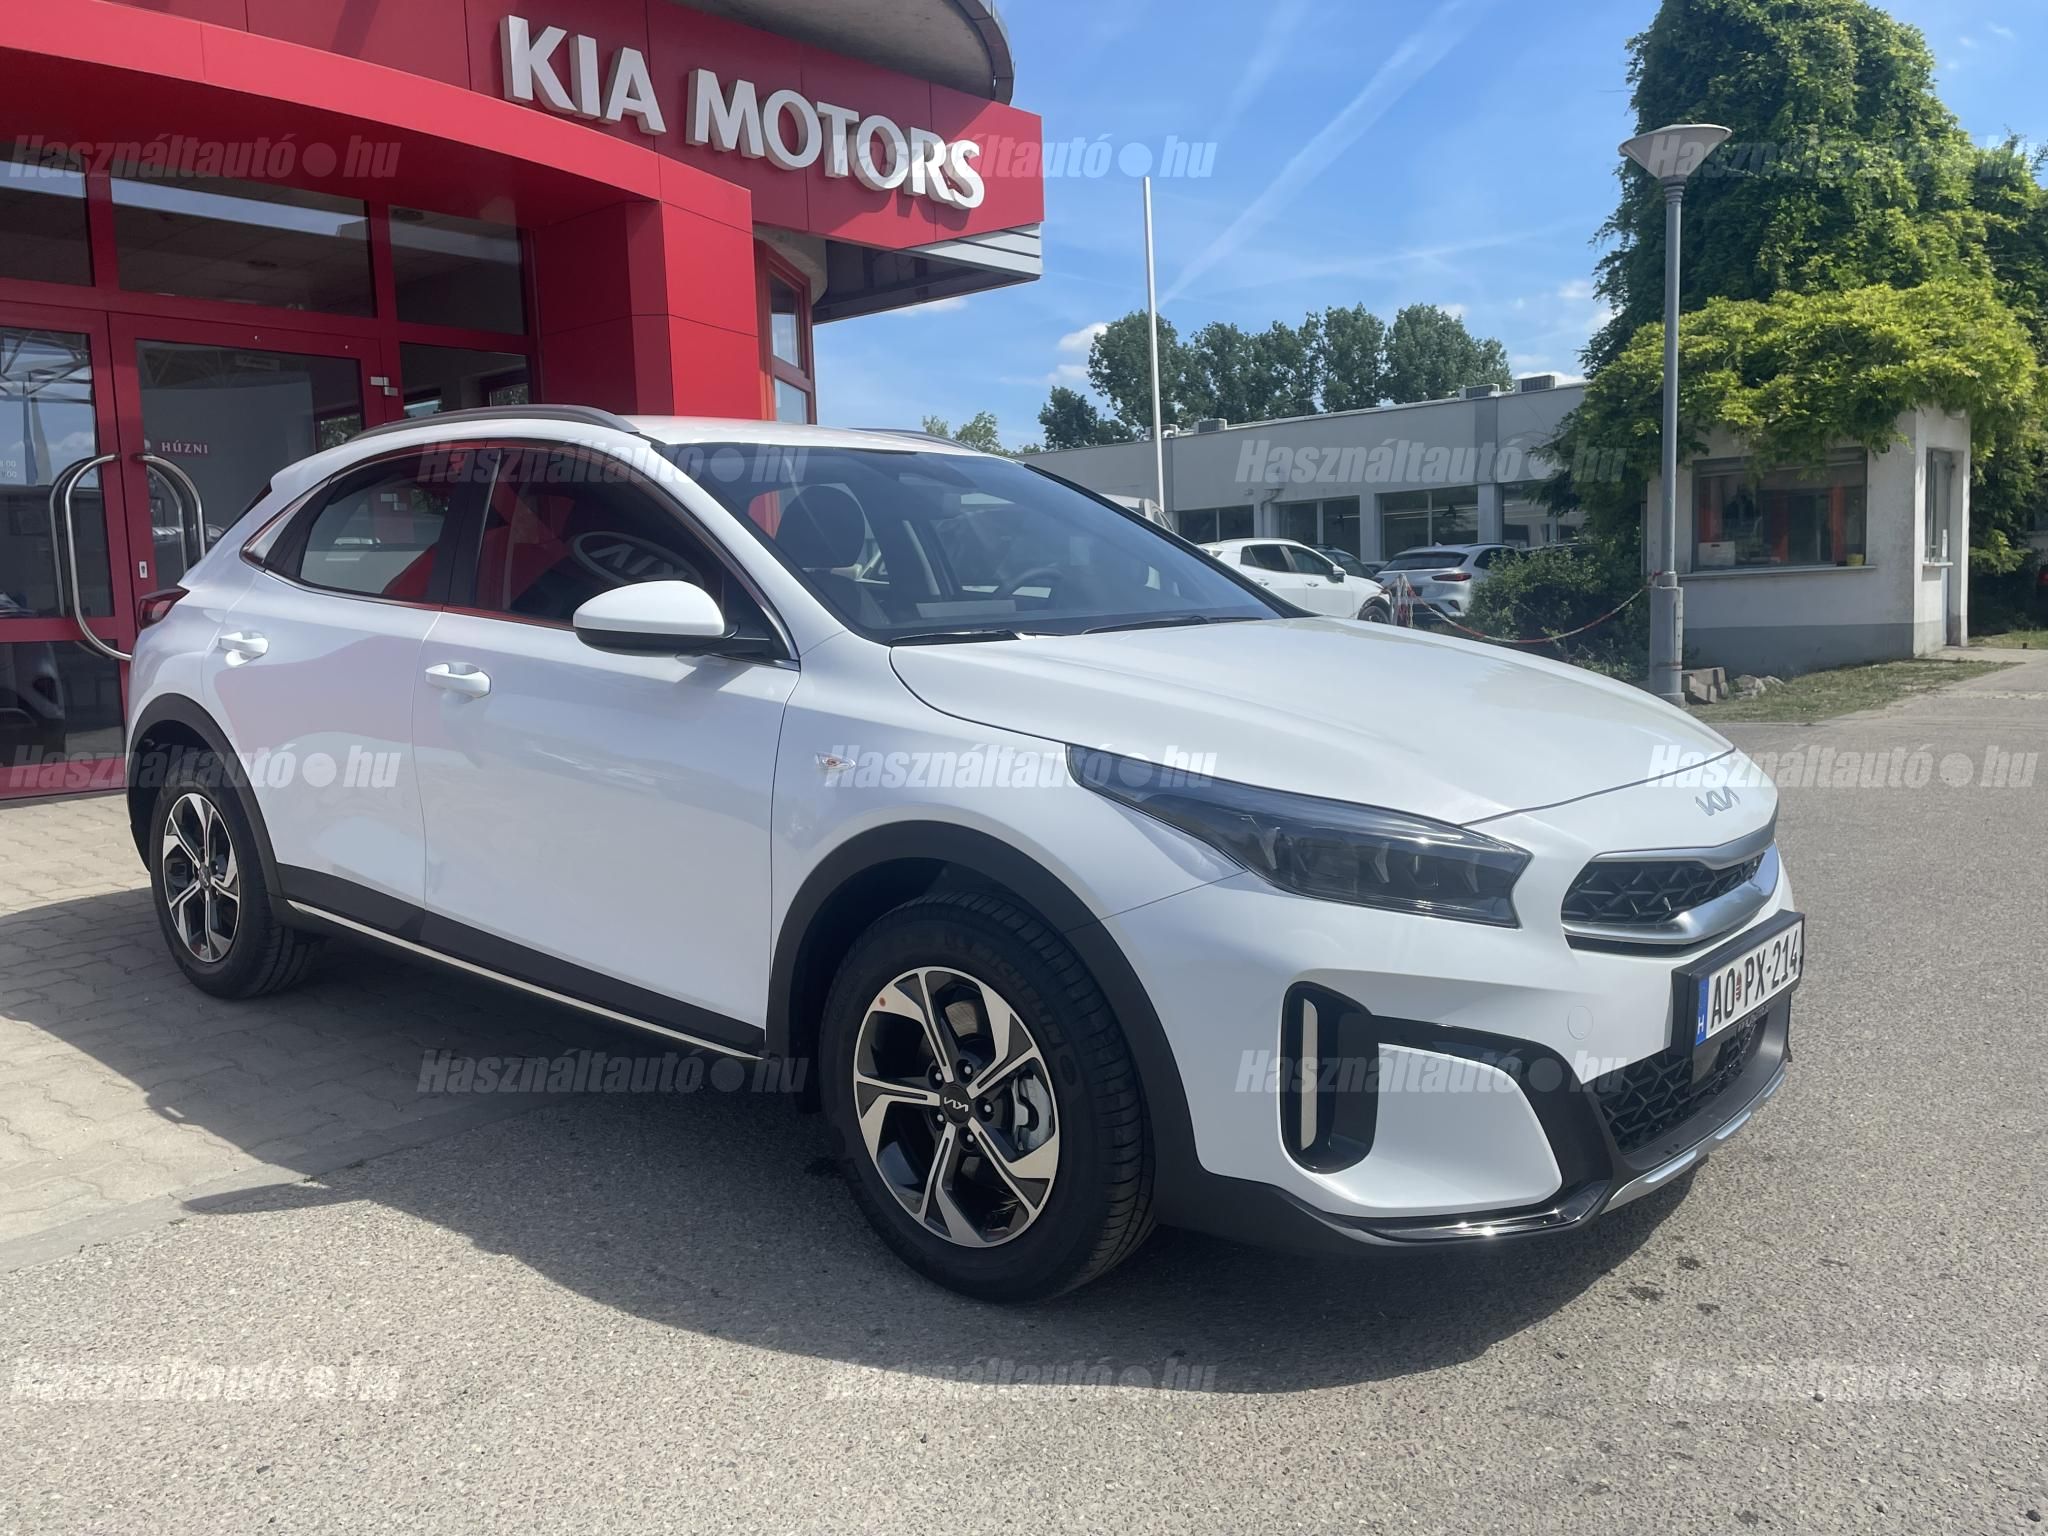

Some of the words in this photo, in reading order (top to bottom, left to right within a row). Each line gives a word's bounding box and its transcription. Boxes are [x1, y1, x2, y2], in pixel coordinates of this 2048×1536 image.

[501, 15, 666, 135] KIA
[686, 68, 985, 209] MOTORS
[161, 440, 208, 454] HÚZNI
